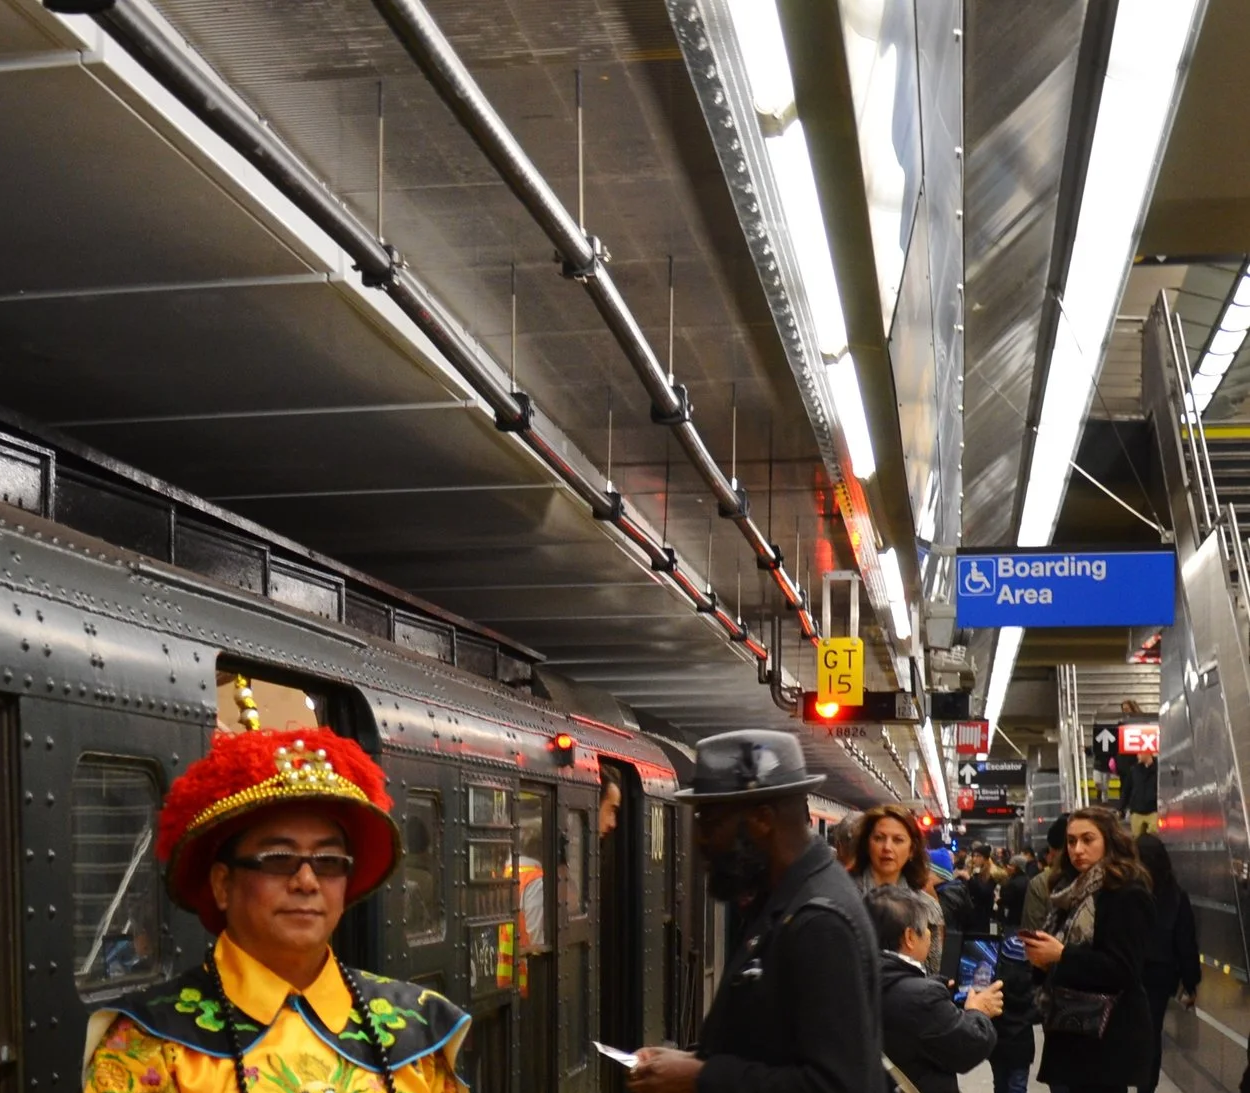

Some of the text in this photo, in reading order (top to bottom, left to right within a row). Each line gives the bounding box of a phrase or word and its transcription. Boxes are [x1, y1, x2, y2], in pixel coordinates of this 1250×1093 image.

[997, 556, 1107, 581] Boarding
[996, 584, 1053, 605] Area
[824, 649, 857, 669] GT
[829, 674, 852, 694] 15
[1123, 728, 1160, 751] Exi
[985, 762, 1022, 771] Escalator
[651, 806, 664, 860] 100
